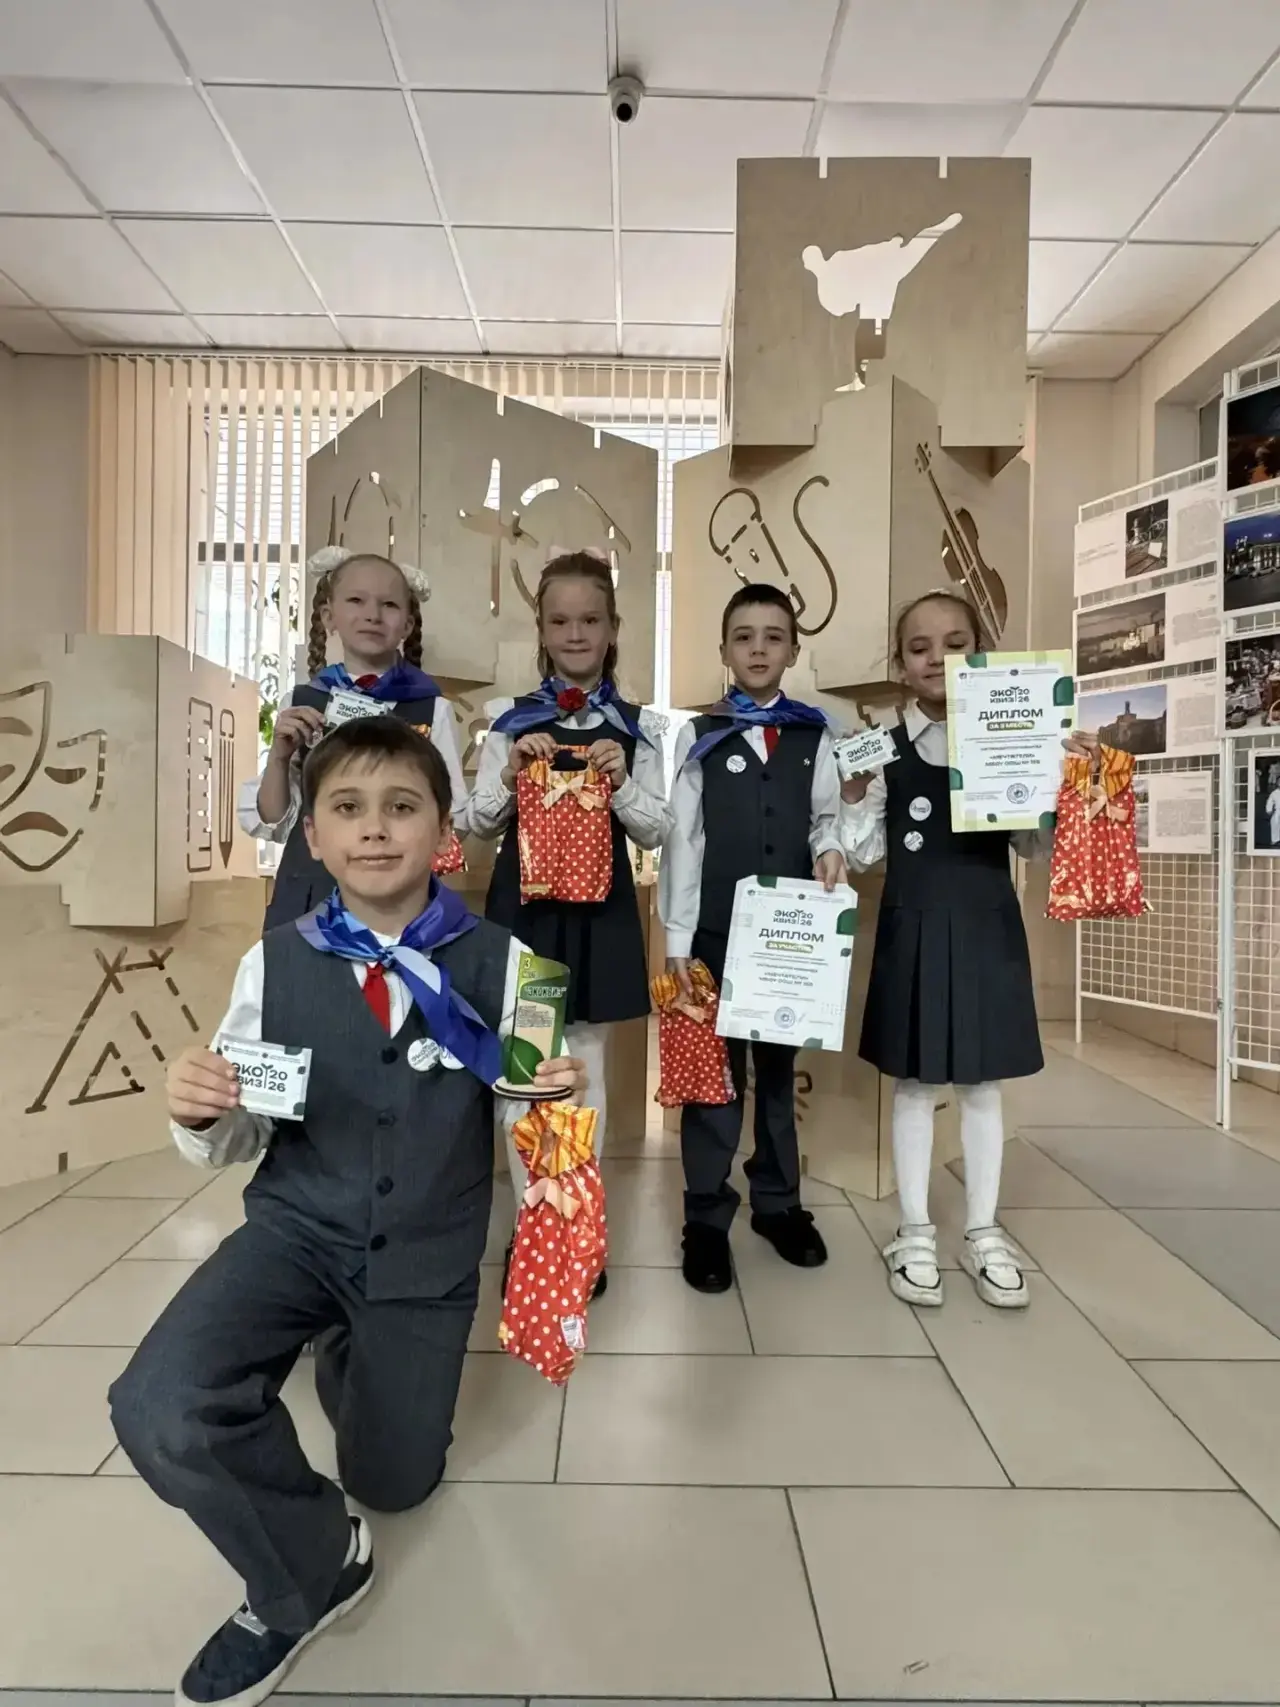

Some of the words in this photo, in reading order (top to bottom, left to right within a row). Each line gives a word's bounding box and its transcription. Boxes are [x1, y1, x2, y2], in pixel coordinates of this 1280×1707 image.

[990, 689, 1012, 697] ЭКО
[338, 703, 358, 714] ЭКО
[978, 708, 1043, 721] ДИПЛОМ
[847, 745, 867, 758] ЭКО
[869, 739, 881, 748] 20
[872, 745, 883, 754] 26
[774, 909, 797, 918] ЭКО
[773, 917, 796, 925] КВИЗ
[758, 928, 824, 943] ДИПЛОМ
[524, 957, 531, 969] 3
[231, 1062, 263, 1078] ЭКО
[269, 1070, 288, 1081] 20
[237, 1075, 263, 1088] ВИЗ
[268, 1081, 286, 1093] 26
